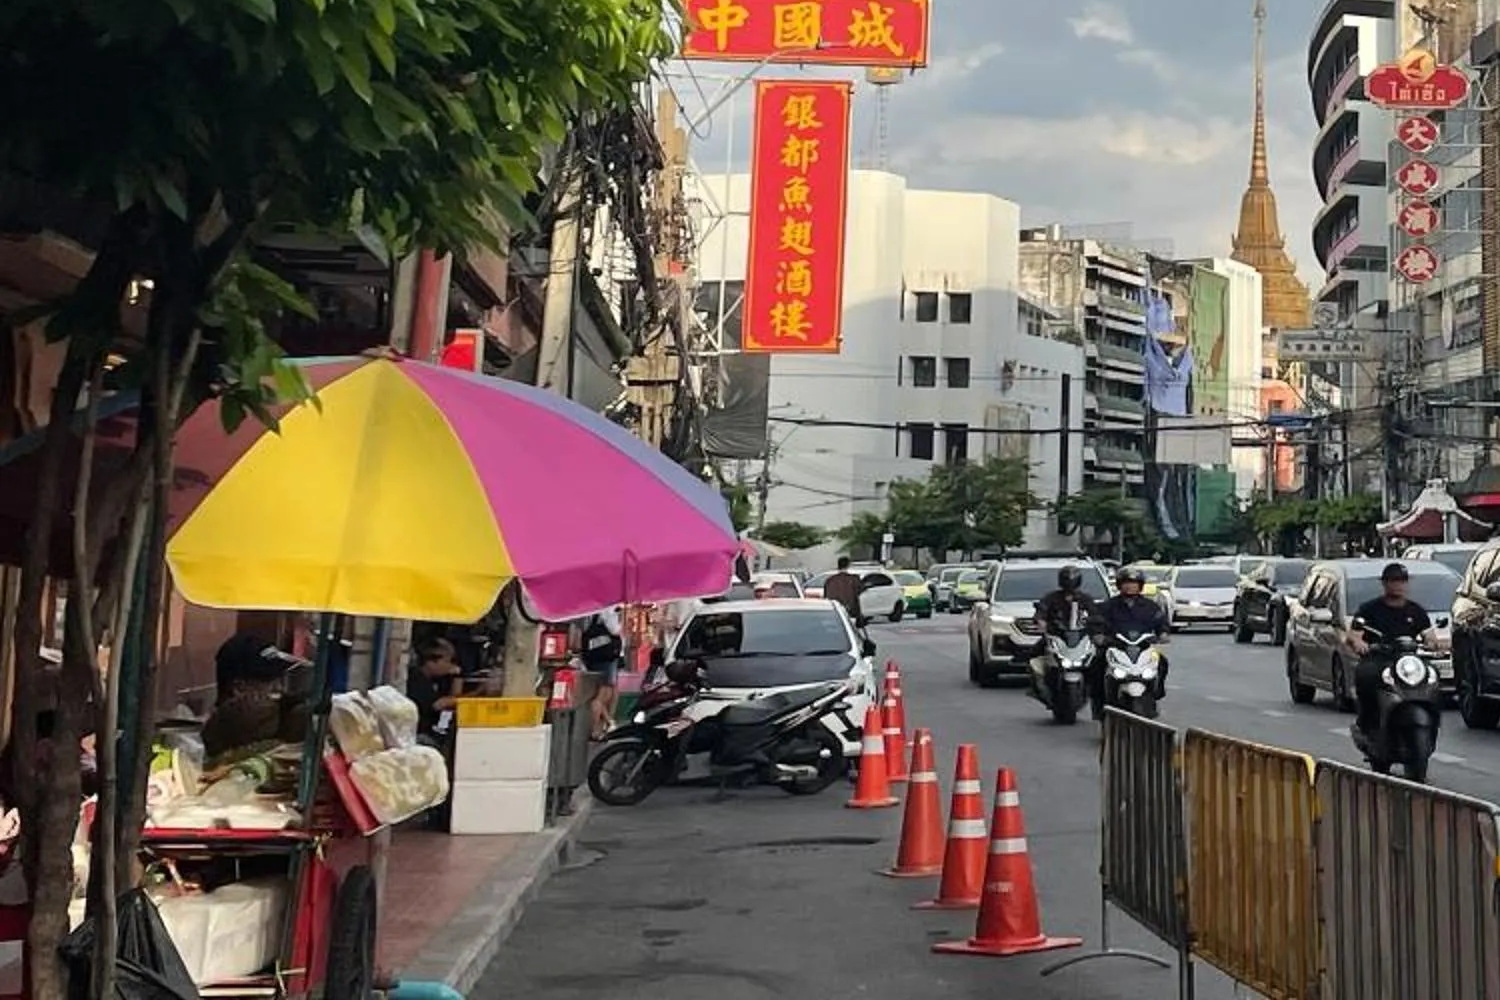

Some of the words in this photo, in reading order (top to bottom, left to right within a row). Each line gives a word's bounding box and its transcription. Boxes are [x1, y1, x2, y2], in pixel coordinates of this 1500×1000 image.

[769, 94, 823, 341] 銀都魚翅酒樓
